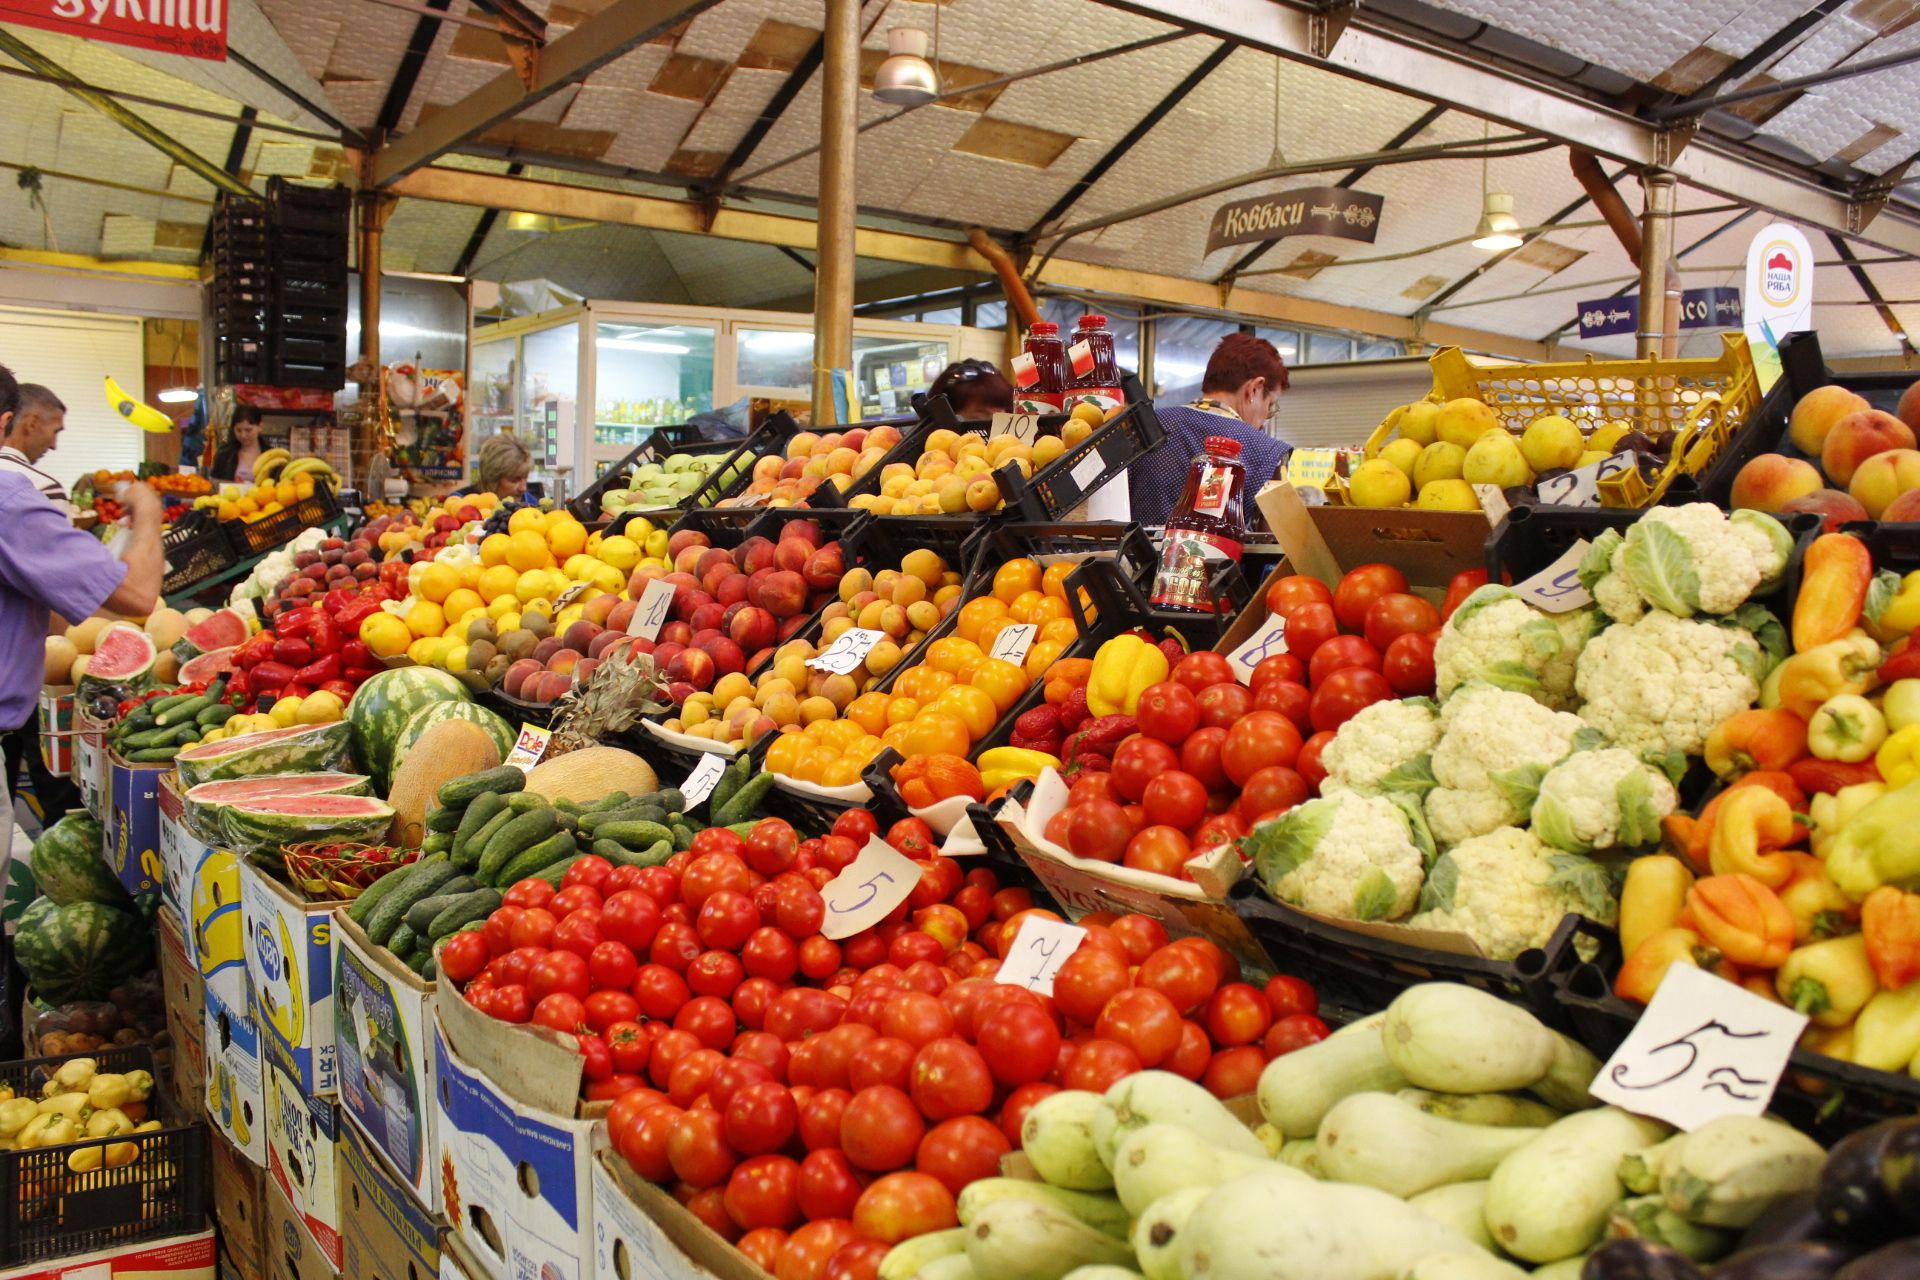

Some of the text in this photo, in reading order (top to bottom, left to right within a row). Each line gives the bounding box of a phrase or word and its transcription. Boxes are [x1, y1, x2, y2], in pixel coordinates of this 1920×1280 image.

[1223, 201, 1305, 238] Ковбаси
[1767, 271, 1792, 282] НАША
[1767, 280, 1792, 292] РЯБА
[1239, 628, 1285, 668] 8
[519, 730, 544, 752] Dole
[828, 871, 895, 913] 5
[378, 1190, 422, 1254] PREMIUM
